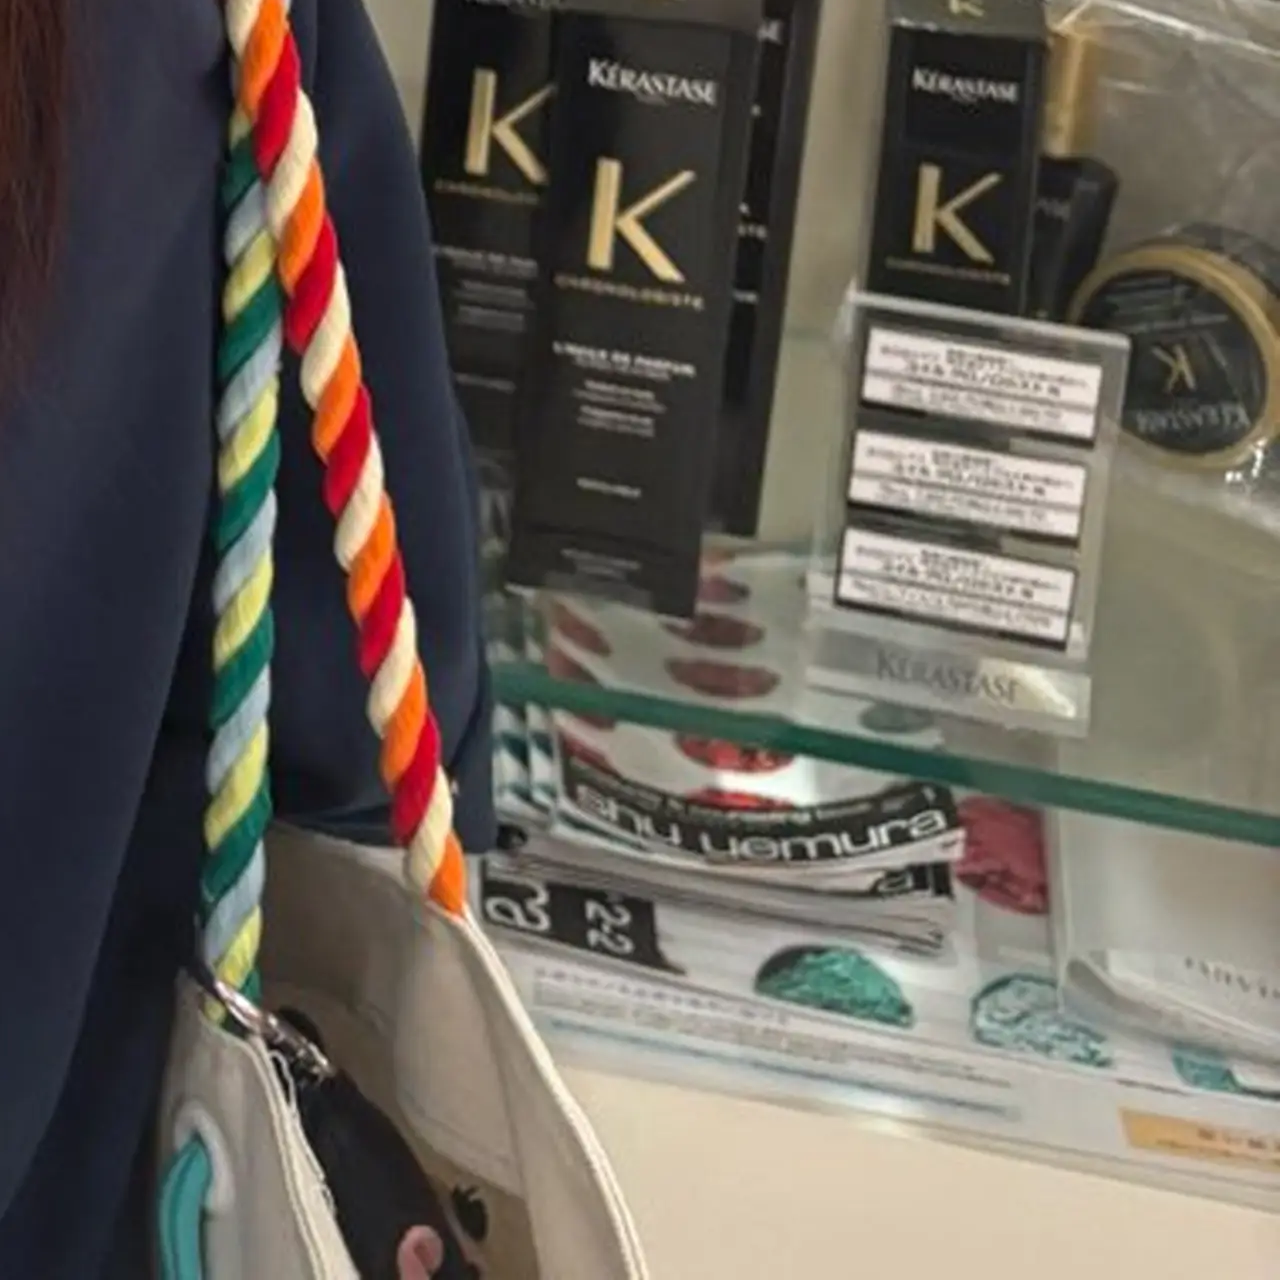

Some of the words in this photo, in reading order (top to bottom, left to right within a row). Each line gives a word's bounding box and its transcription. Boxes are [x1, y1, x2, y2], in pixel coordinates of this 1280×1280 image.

[589, 58, 718, 106] KÉRASTASE
[911, 66, 1020, 104] KÉRASTASE
[464, 66, 558, 186] K
[587, 155, 697, 284] K
[912, 161, 1003, 264] K
[701, 808, 948, 861] uemura
